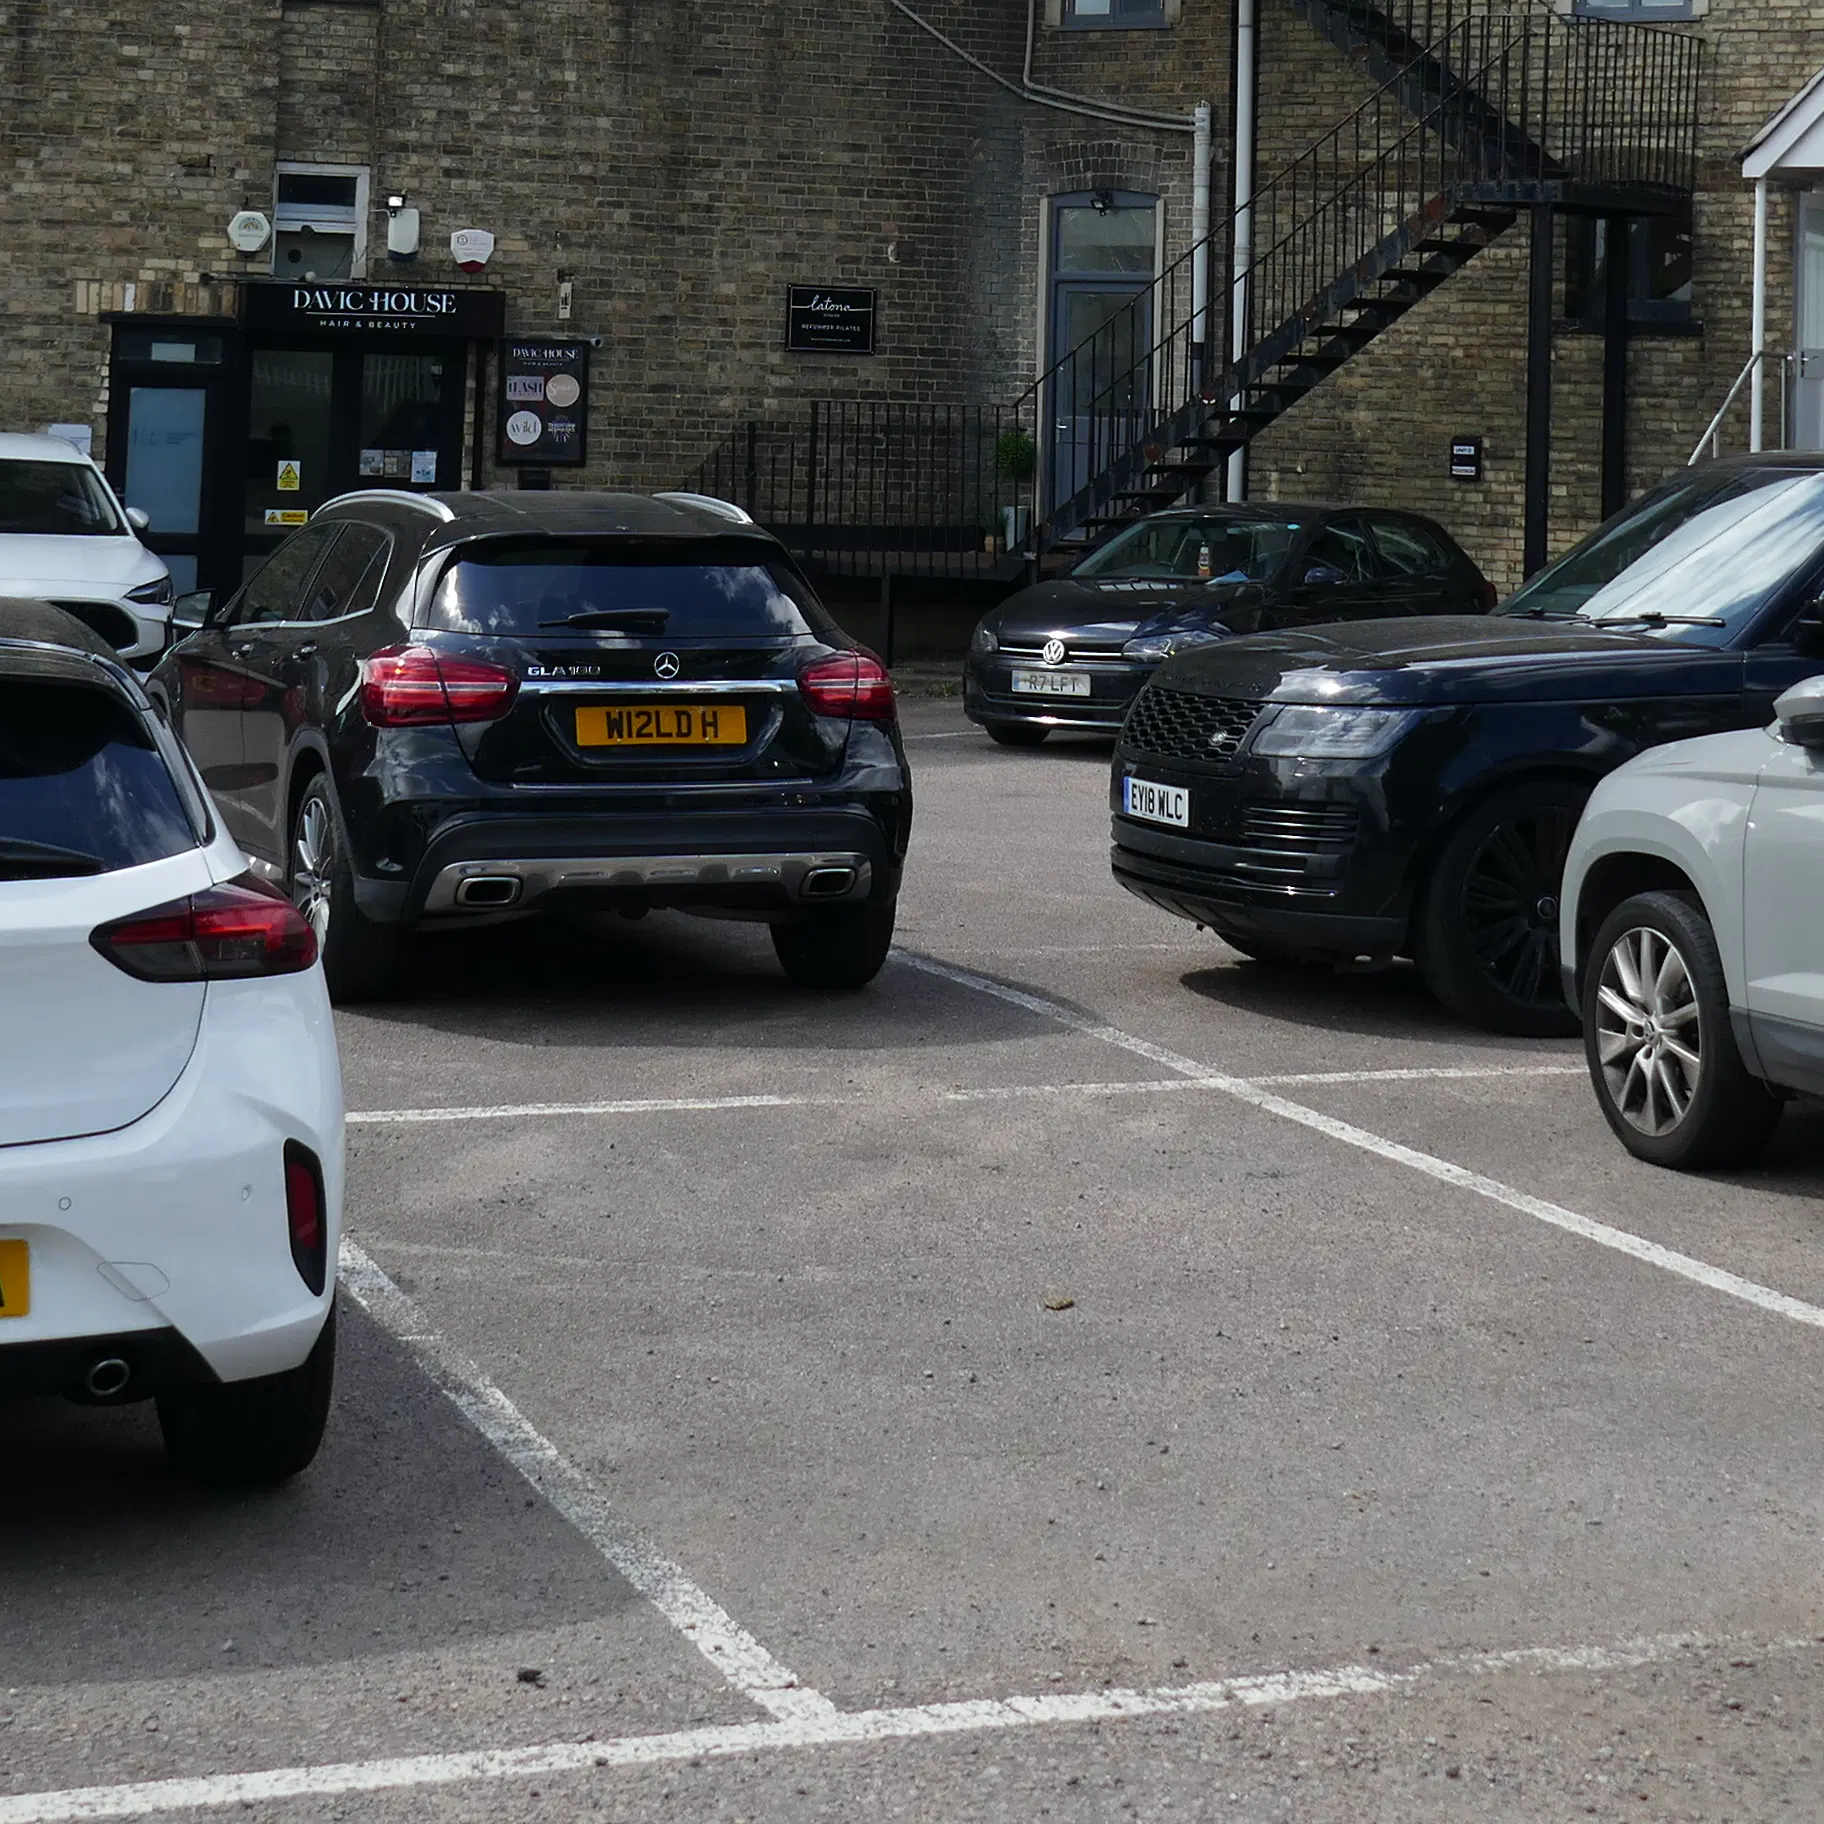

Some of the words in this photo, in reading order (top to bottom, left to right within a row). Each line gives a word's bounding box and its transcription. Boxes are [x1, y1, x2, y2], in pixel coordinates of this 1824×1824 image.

[293, 289, 364, 310] DAVIC
[369, 291, 457, 314] HOUSE
[368, 321, 417, 329] BEAUTY
[1028, 674, 1046, 690] R7
[701, 710, 718, 739] H
[1132, 783, 1155, 814] EY18
[1157, 788, 1183, 821] WLC
